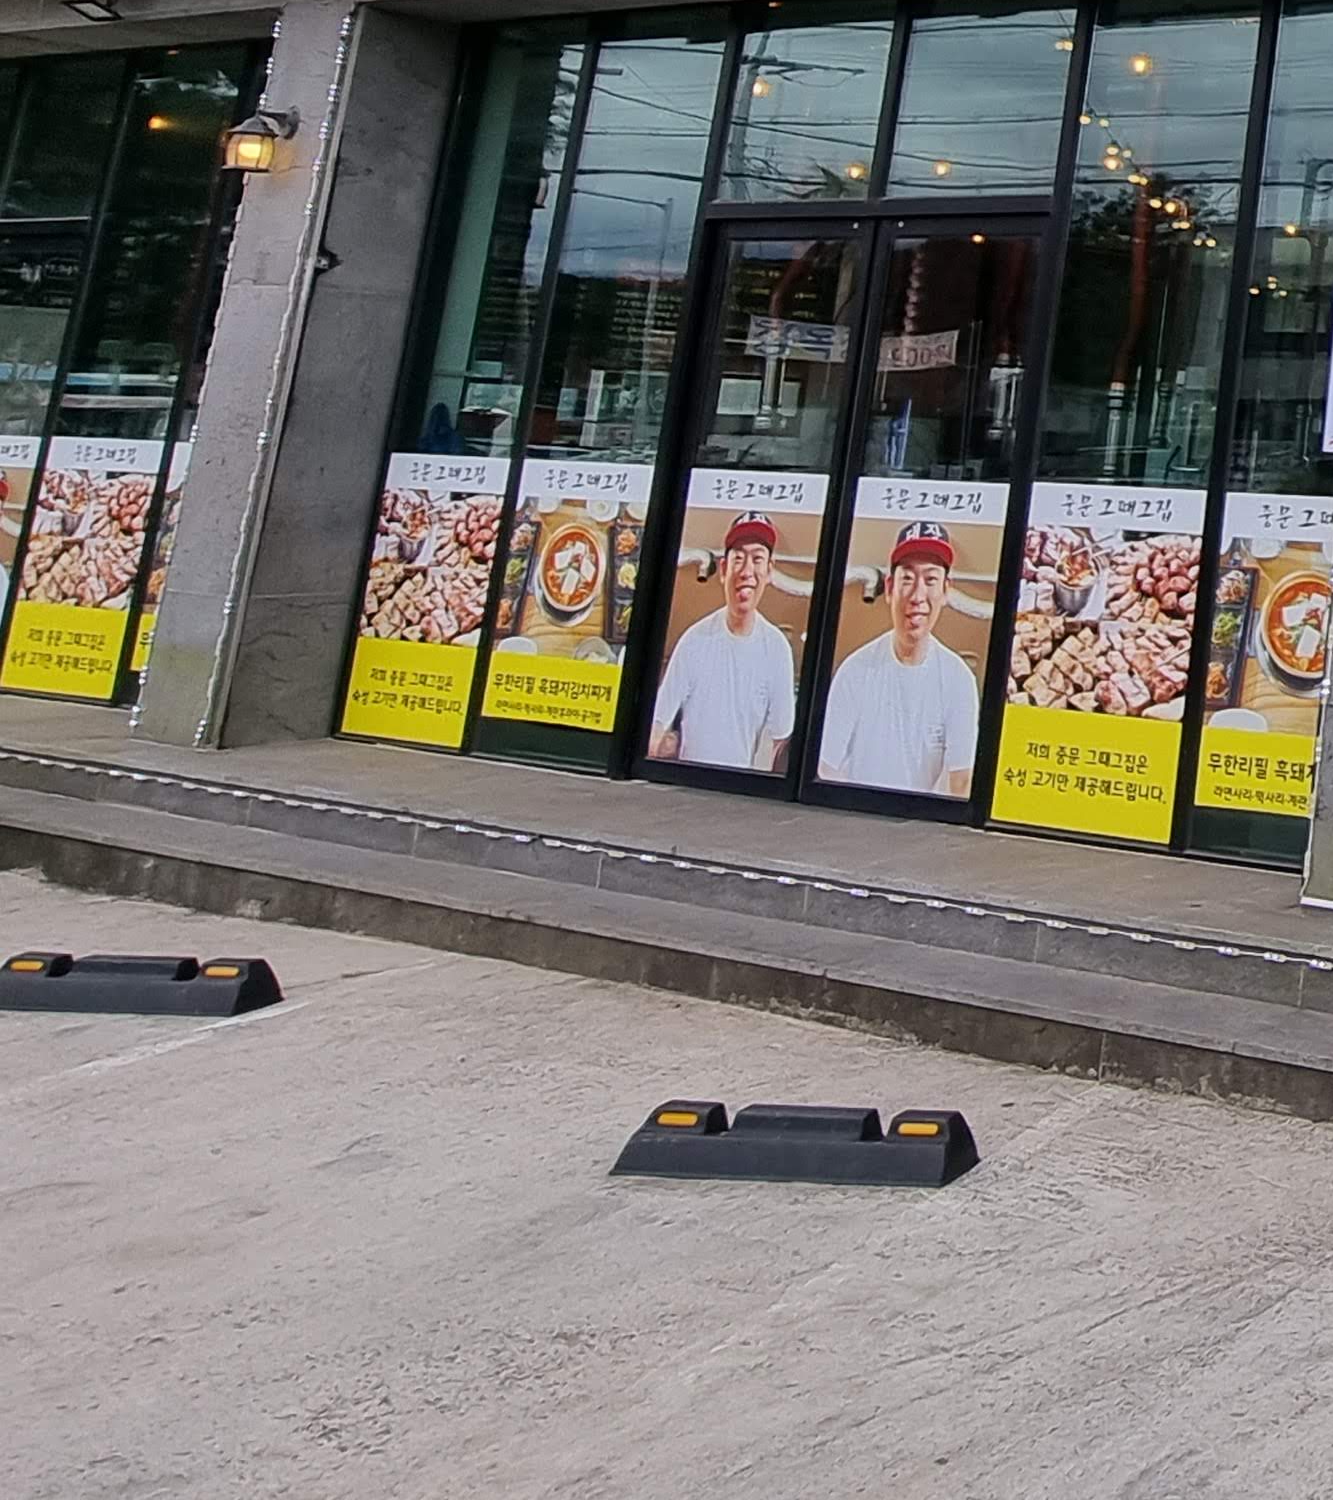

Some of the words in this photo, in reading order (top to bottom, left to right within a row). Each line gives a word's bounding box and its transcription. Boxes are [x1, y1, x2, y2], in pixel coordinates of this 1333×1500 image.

[712, 478, 737, 499] 중문
[741, 482, 804, 504] 그때그집
[882, 487, 911, 510] 중문
[914, 491, 984, 515] 그때그집
[1060, 492, 1093, 519] 중문
[1098, 497, 1173, 523] 그때그집
[1257, 504, 1294, 529] 중문
[1026, 741, 1051, 760] 저희
[1055, 745, 1081, 766] 중문
[1084, 748, 1149, 775] 그때그집은
[1207, 752, 1269, 780] 무한리필
[1003, 766, 1028, 788] 숙성
[1032, 769, 1070, 793] 고기만
